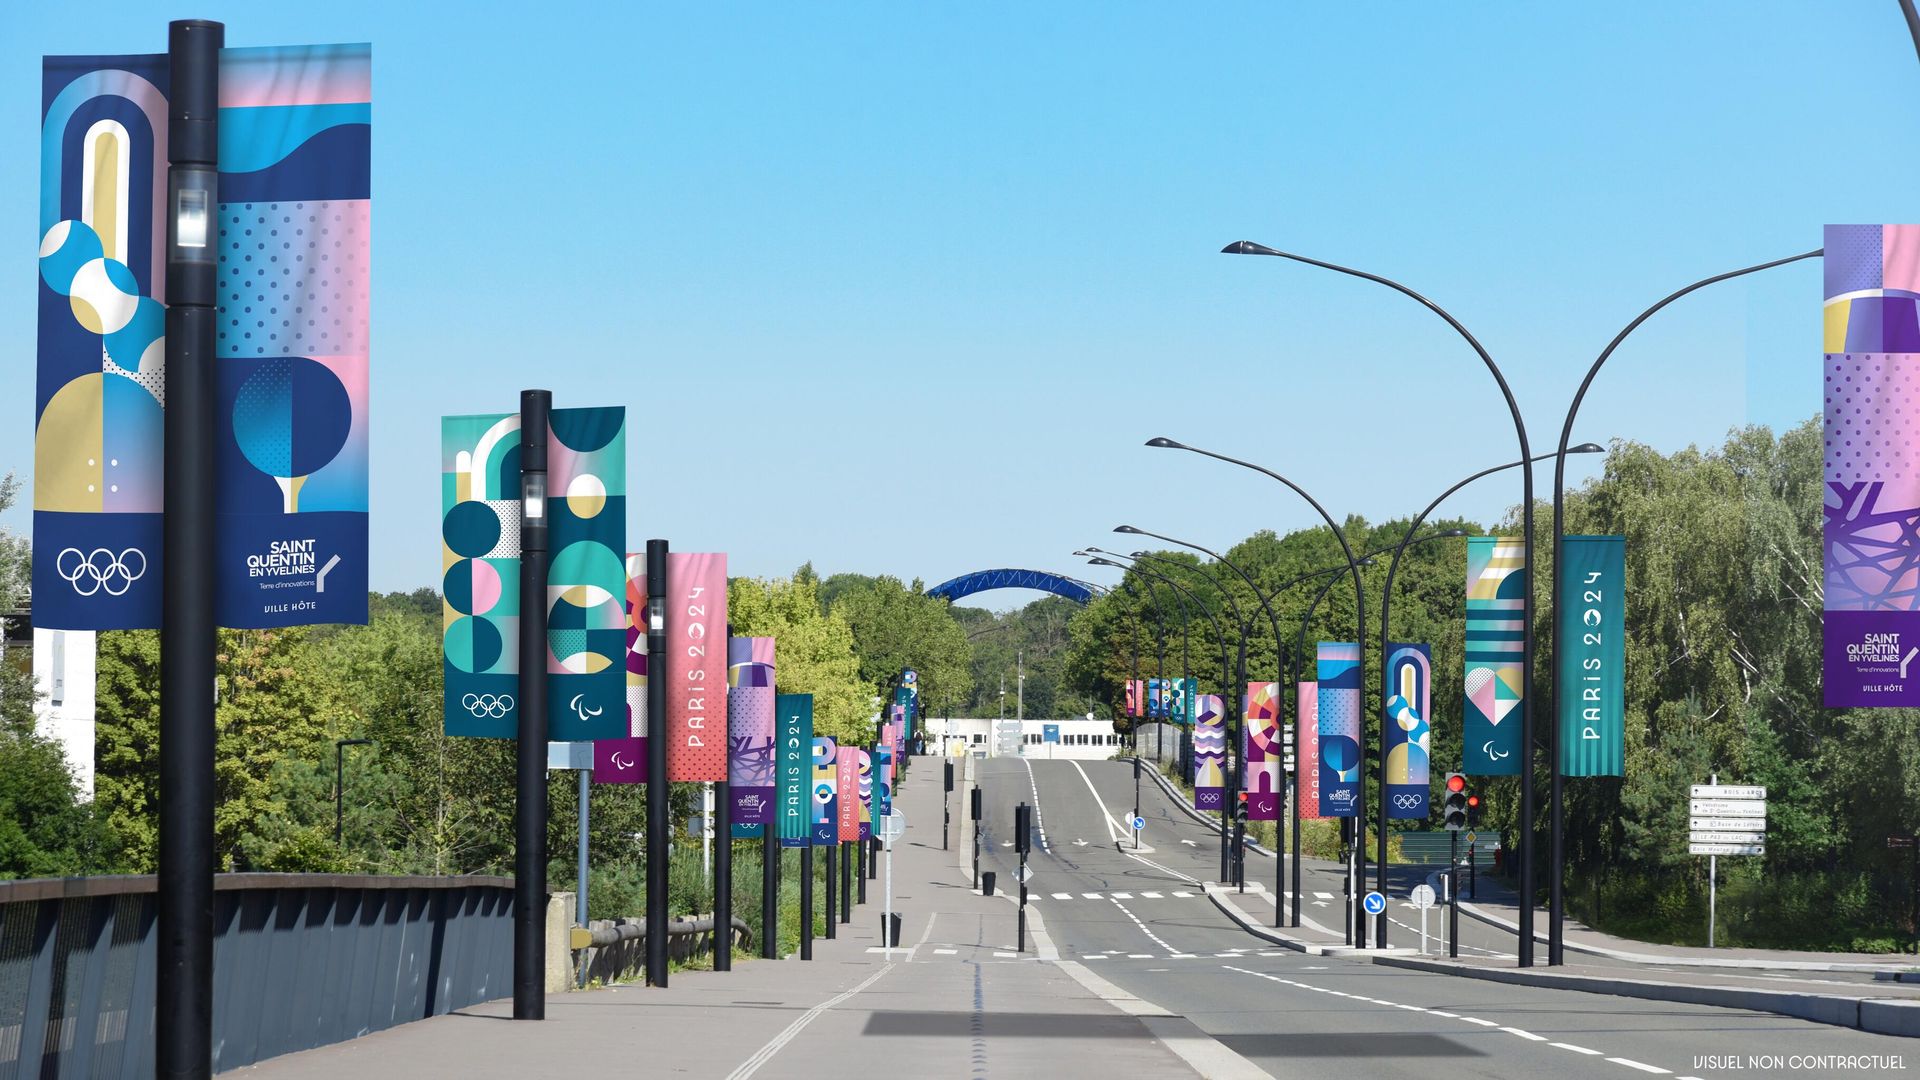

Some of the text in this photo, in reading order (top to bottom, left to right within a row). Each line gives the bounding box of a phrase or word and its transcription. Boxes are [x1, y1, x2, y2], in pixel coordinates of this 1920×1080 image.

[270, 539, 316, 554] SAINT
[246, 552, 315, 568] QUENTIN
[249, 564, 315, 577] EN YVELINES
[275, 580, 315, 589] d'innovations
[264, 600, 316, 613] VILLE HÔTE
[1864, 633, 1900, 644] SAINT
[1846, 643, 1900, 655] QUENTIN
[1848, 654, 1900, 662] EN YVELINES
[1884, 683, 1903, 692] HÔTE
